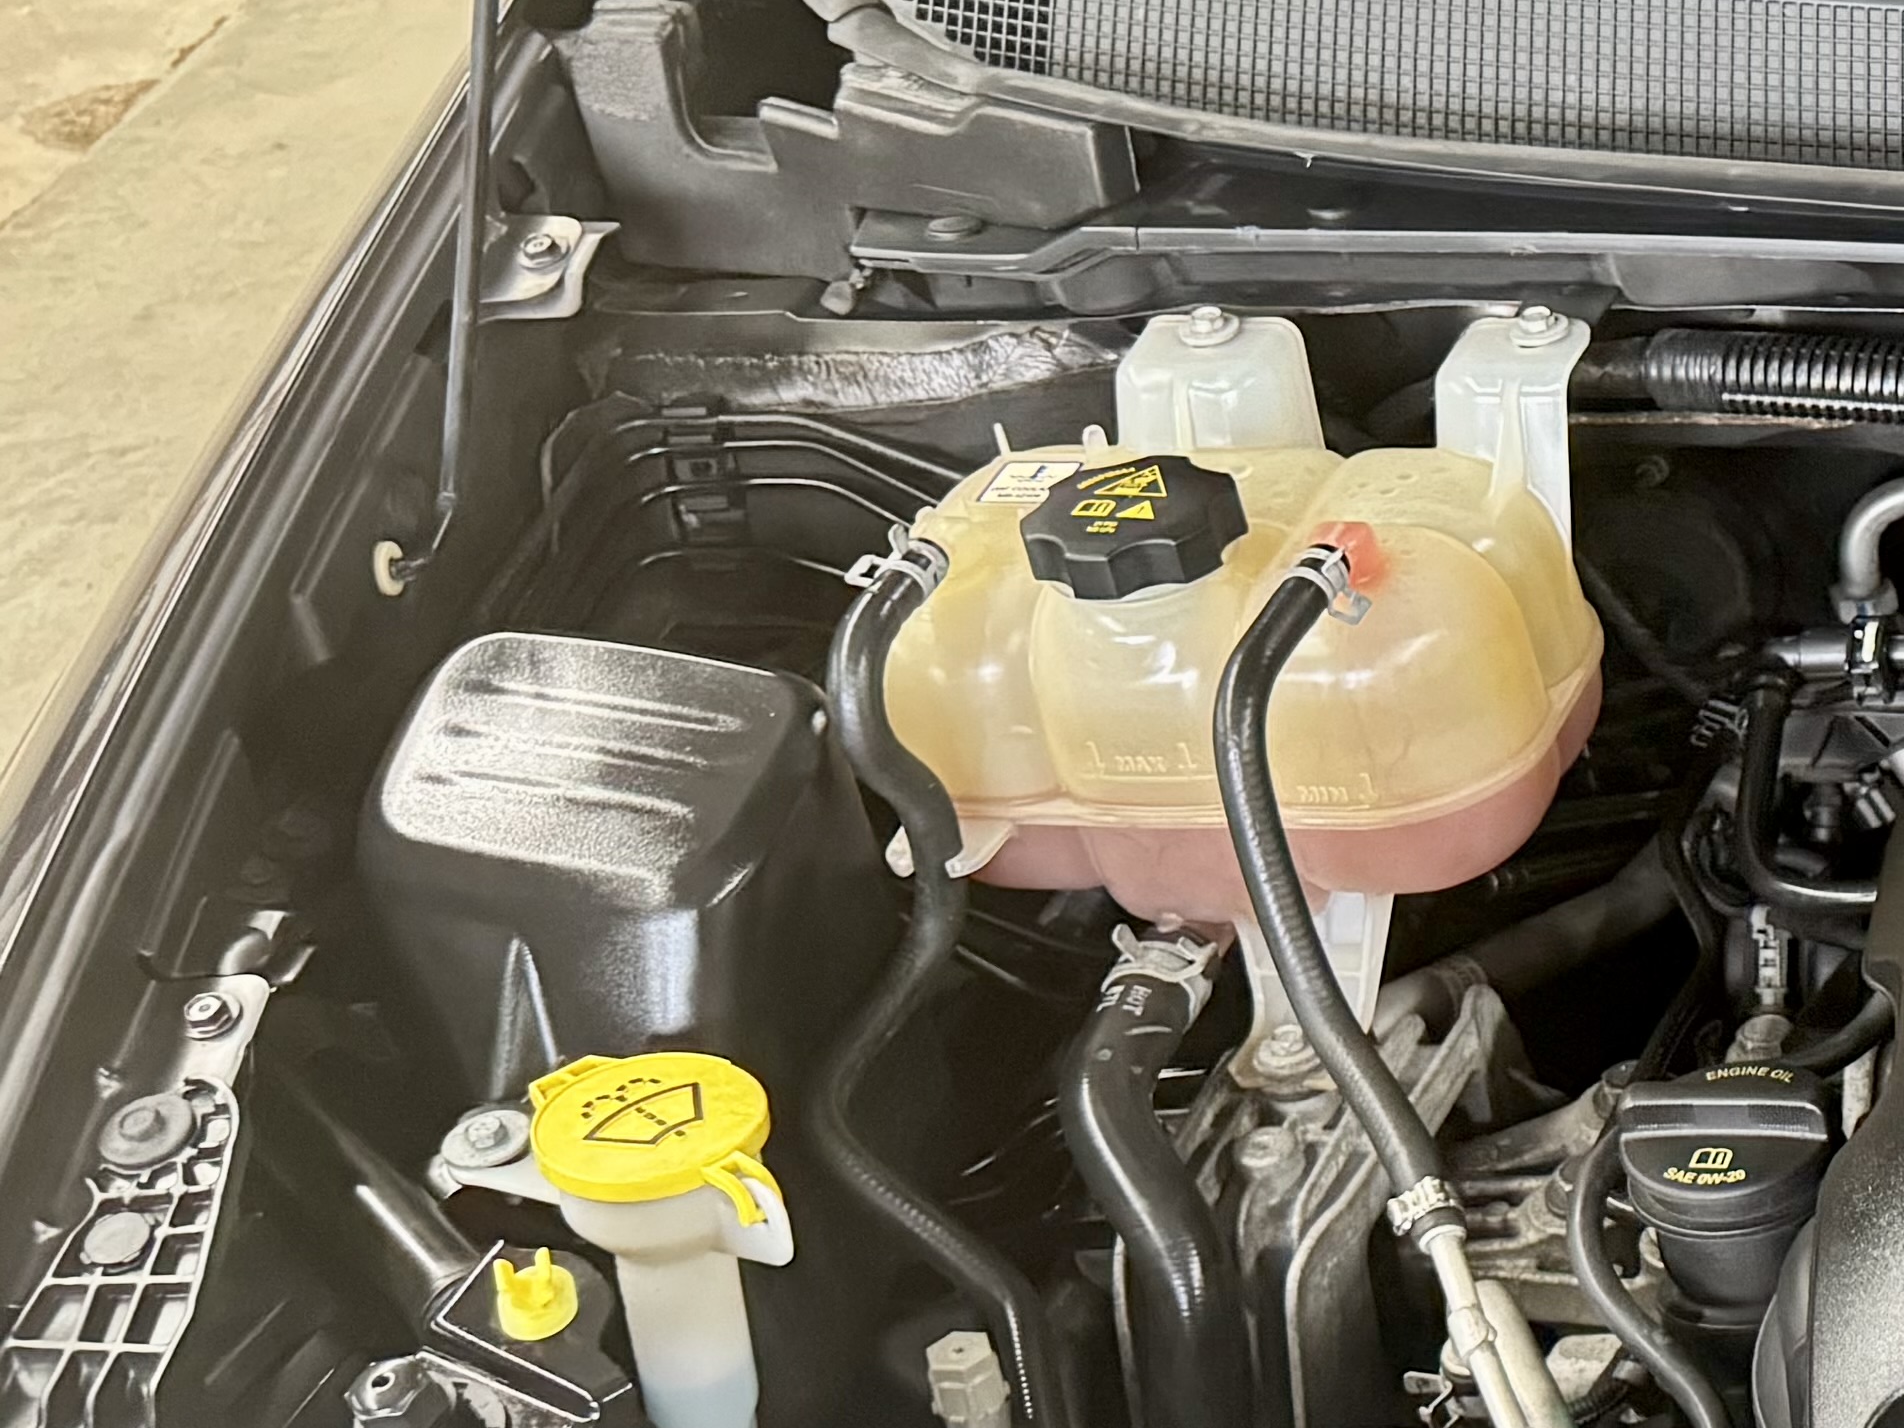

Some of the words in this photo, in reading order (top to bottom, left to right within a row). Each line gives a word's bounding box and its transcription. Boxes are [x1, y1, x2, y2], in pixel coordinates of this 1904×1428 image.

[1705, 1065, 1770, 1081] ENGINE
[1770, 1068, 1794, 1083] OIL
[1662, 1167, 1698, 1185] SAE
